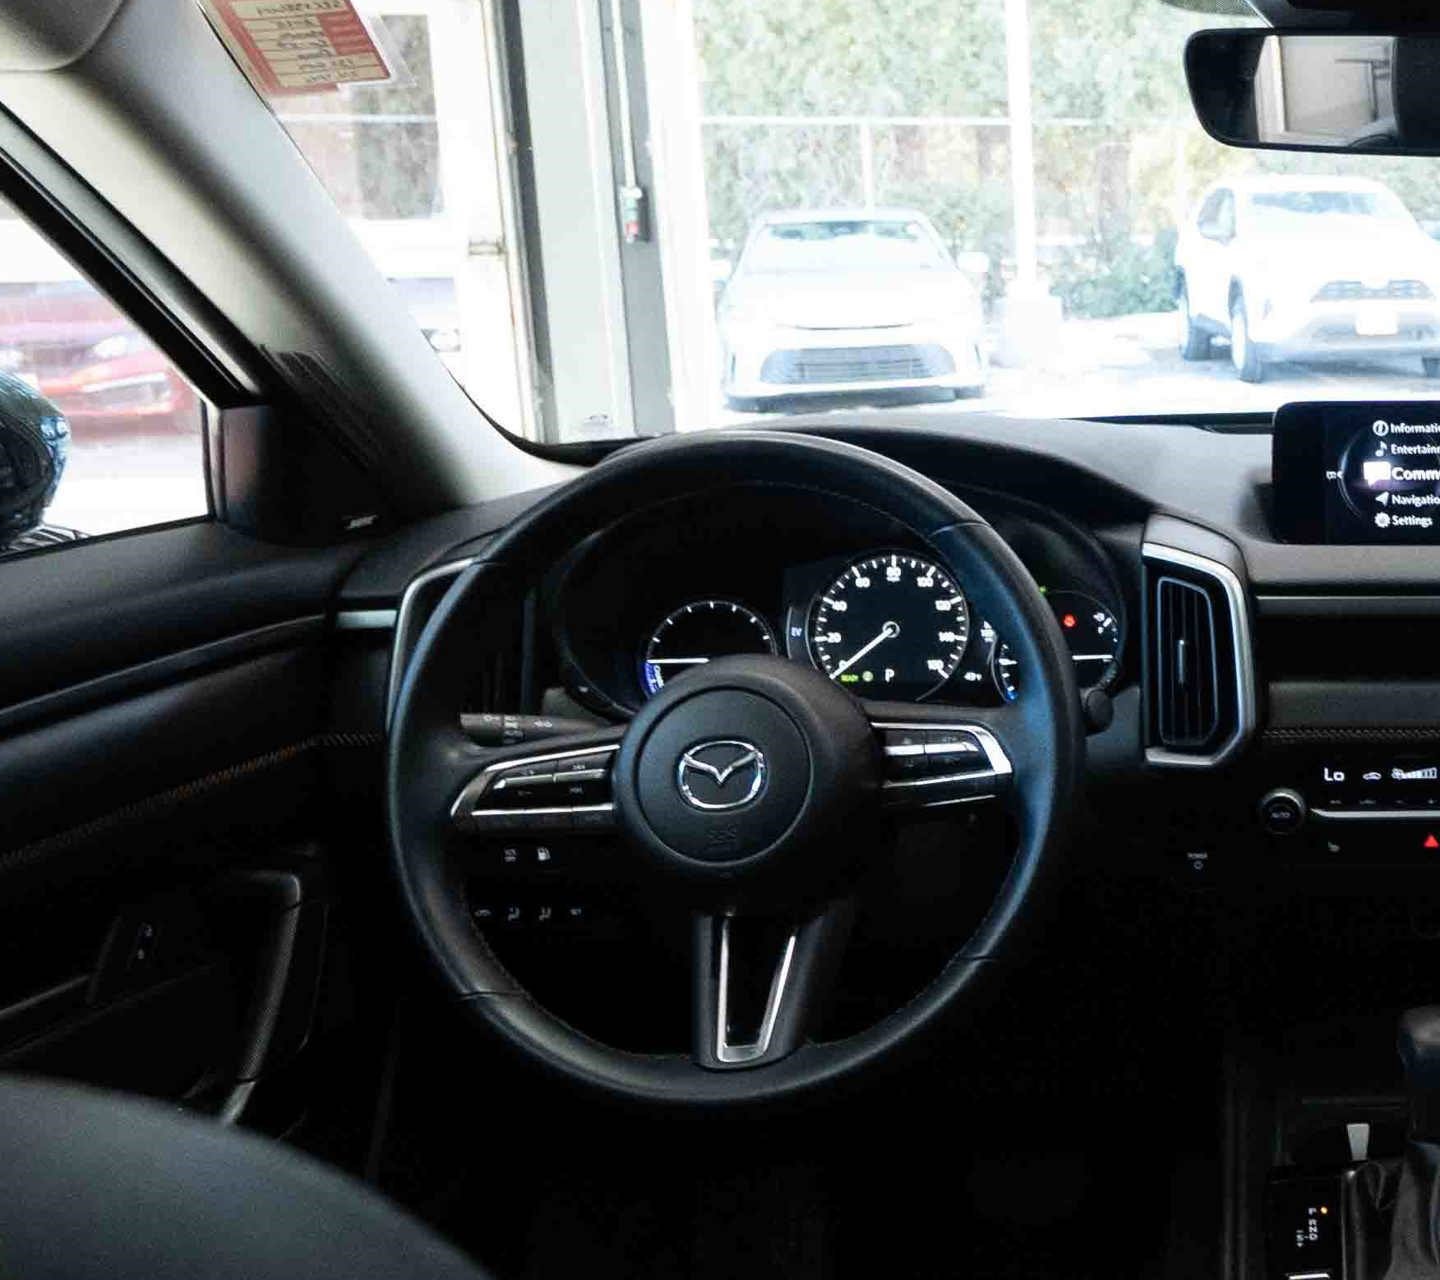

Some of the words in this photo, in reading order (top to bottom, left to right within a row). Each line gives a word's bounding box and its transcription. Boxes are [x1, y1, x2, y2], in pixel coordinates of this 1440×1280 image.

[1391, 515, 1432, 528] Settings
[827, 632, 841, 643] 20
[885, 668, 895, 682] P
[1324, 767, 1345, 781] Lo
